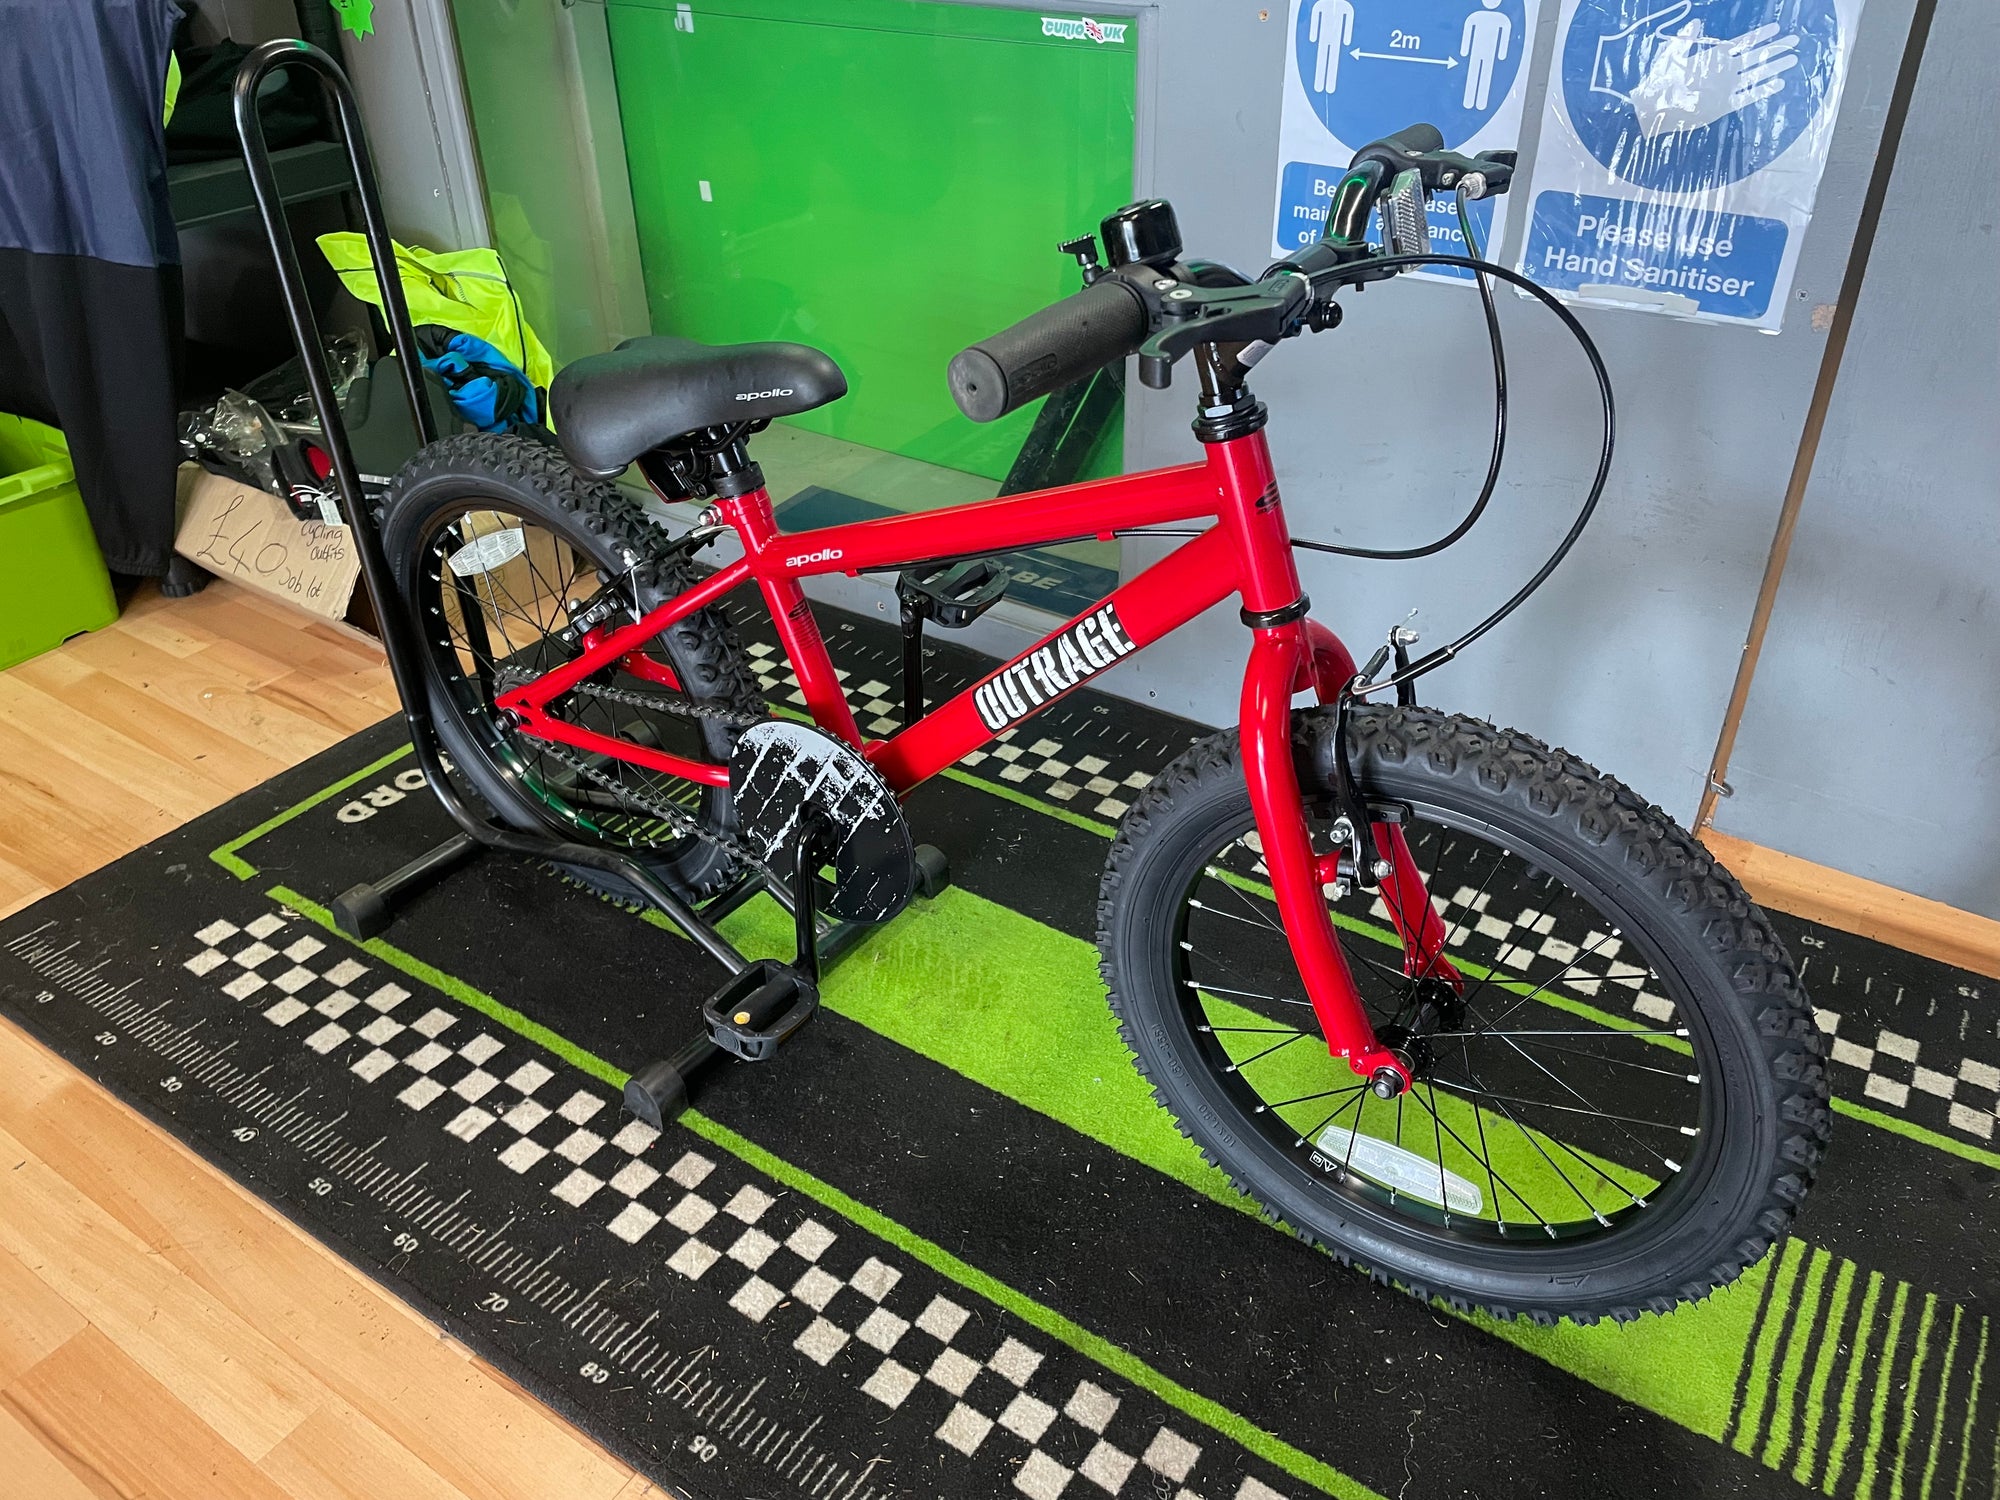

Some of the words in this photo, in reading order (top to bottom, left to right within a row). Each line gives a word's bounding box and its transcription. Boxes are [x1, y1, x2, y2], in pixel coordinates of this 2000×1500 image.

[1044, 20, 1085, 37] CURIO
[1103, 25, 1123, 40] UK
[1389, 29, 1421, 50] 2m
[1424, 199, 1457, 216] ase
[1298, 229, 1317, 245] of
[1576, 214, 1671, 250] Please
[1679, 234, 1733, 258] use
[1543, 245, 1617, 278] Hand
[1623, 257, 1755, 297] Sanitiser
[735, 388, 794, 402] apollo
[196, 494, 288, 574] £40
[785, 548, 843, 568] apollo
[974, 602, 1137, 730] OUTRAGE
[34, 989, 55, 1004] 10
[94, 1031, 118, 1046] 20
[160, 1075, 183, 1093] 30
[231, 1126, 257, 1143] 40
[308, 1177, 333, 1197] 50
[393, 1232, 419, 1253] 60
[482, 1291, 510, 1313] 70
[579, 1361, 610, 1384] 80
[687, 1435, 718, 1463] 90
